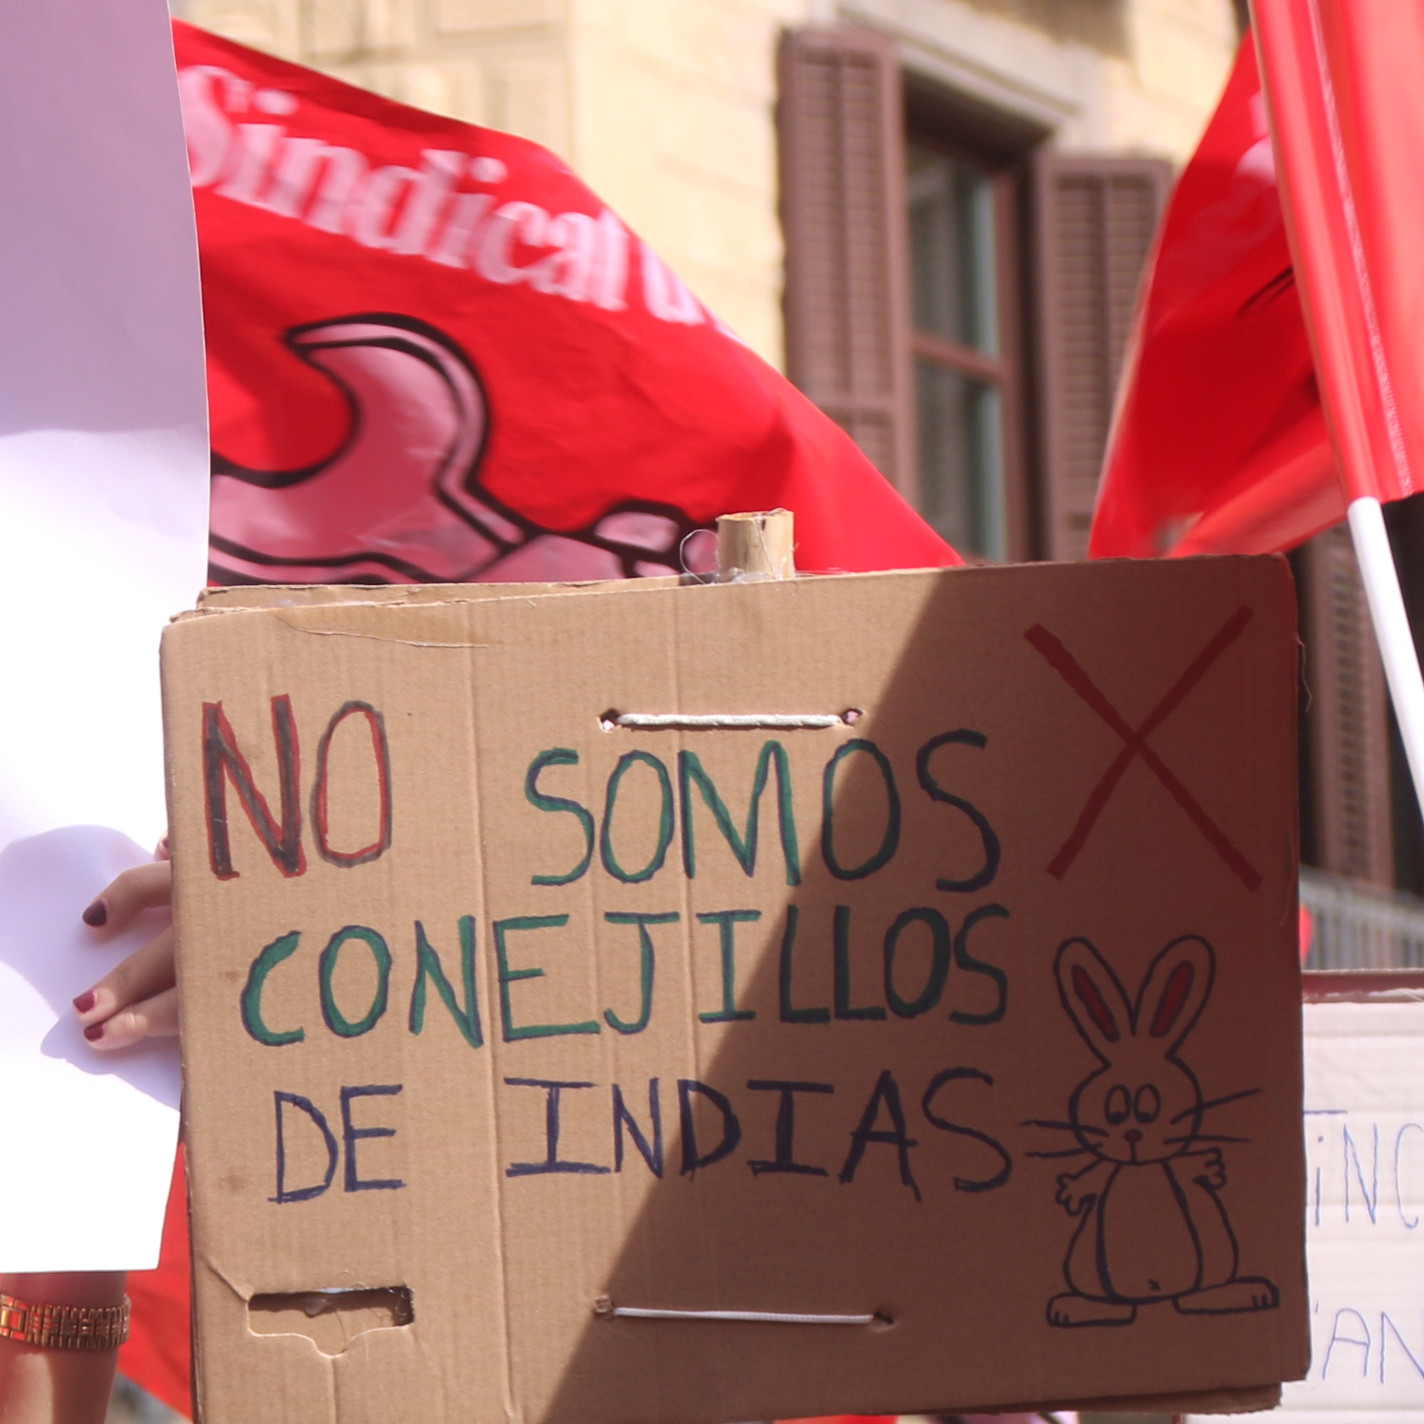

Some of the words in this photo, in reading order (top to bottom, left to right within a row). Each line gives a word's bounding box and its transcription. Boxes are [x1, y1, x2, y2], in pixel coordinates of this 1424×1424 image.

[202, 693, 393, 881] NO
[523, 729, 1001, 893] SOMOS
[240, 904, 1011, 1048] CONEJILLOS
[267, 1084, 405, 1204] DE
[503, 1068, 1013, 1202] INDIAS
